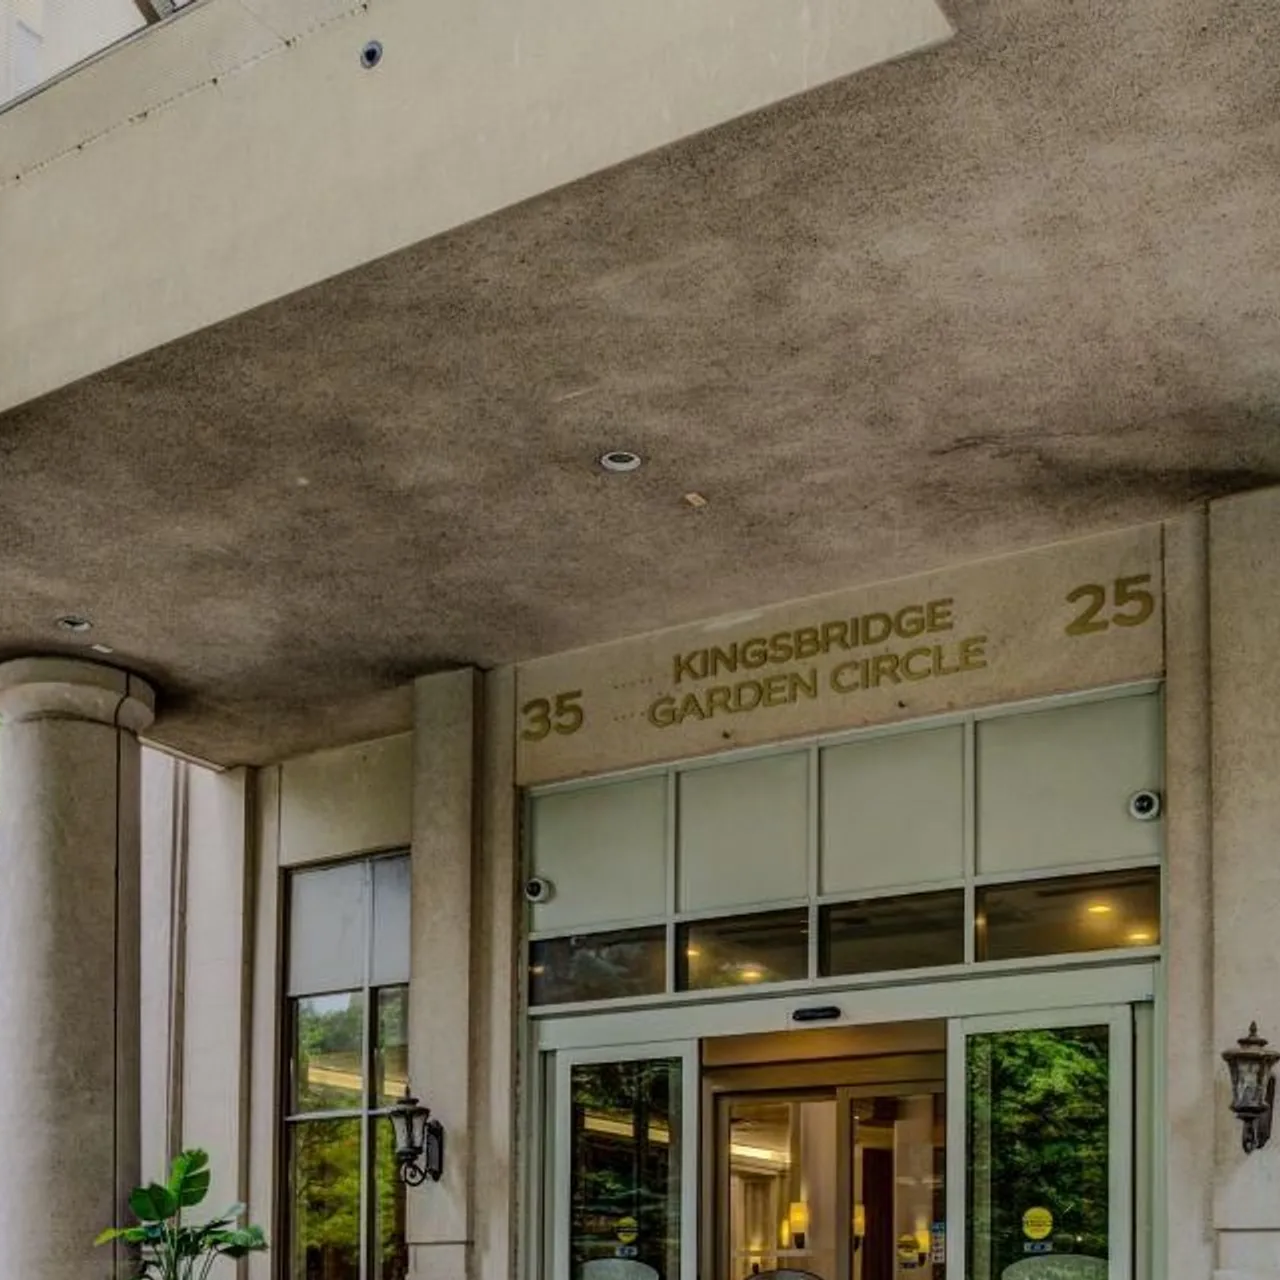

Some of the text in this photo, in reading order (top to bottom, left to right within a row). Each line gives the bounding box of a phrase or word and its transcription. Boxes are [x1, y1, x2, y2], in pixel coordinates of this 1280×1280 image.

[673, 598, 953, 684] KINGSBRIDGE
[1064, 574, 1154, 637] 25
[521, 689, 583, 742] 35
[648, 635, 987, 728] GARDEN CIRCLE
